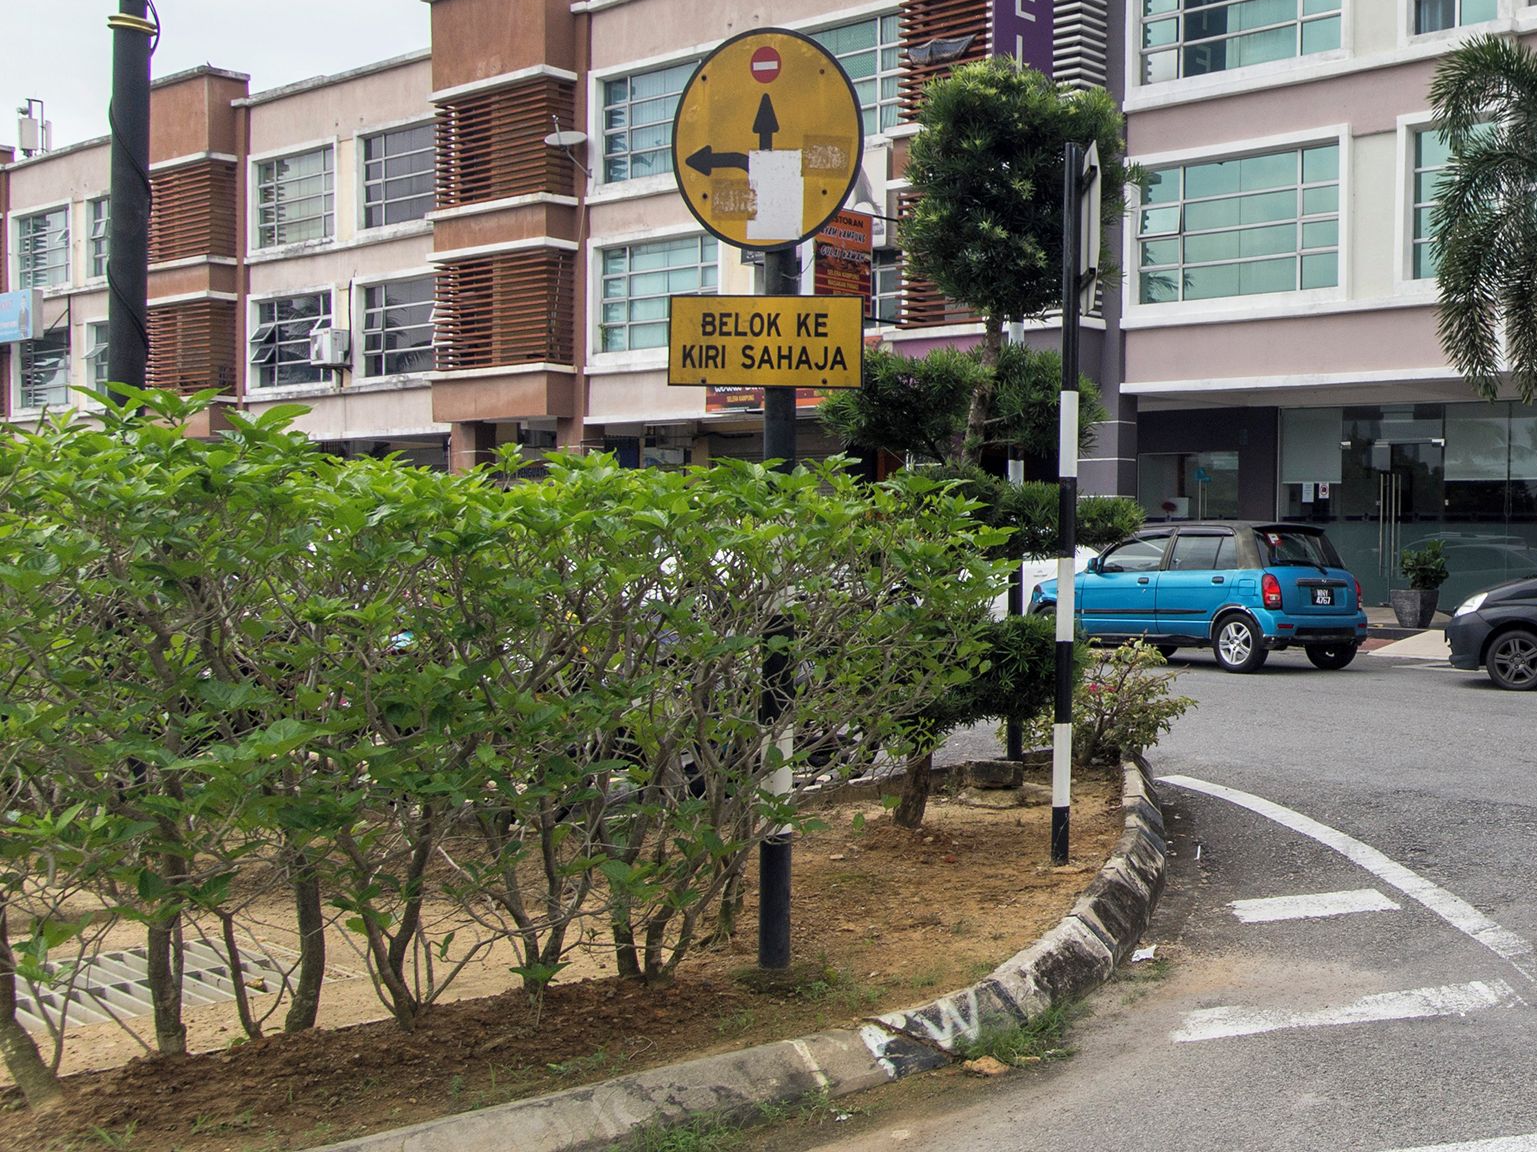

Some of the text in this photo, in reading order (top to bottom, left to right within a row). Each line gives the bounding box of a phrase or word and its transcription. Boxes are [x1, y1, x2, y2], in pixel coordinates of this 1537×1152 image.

[701, 312, 829, 337] BELOK KE
[682, 344, 848, 370] KIRI SAHAJA
